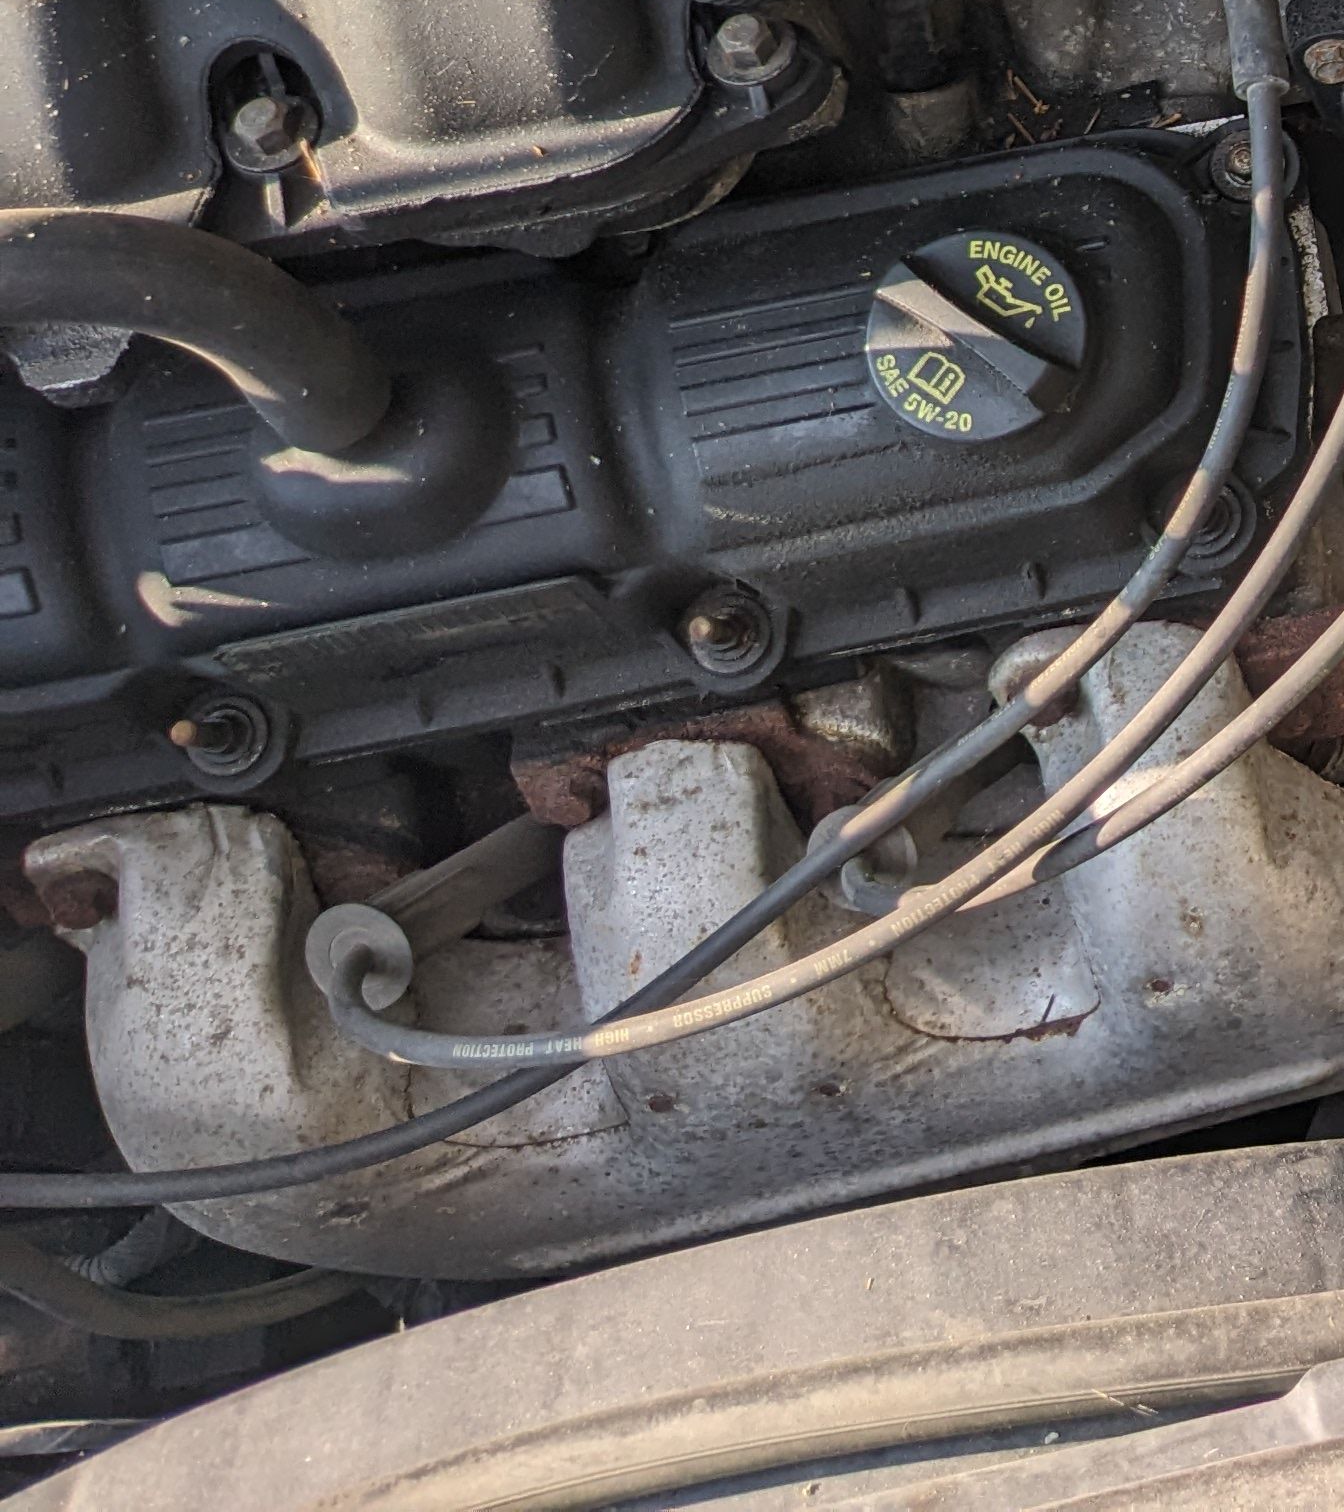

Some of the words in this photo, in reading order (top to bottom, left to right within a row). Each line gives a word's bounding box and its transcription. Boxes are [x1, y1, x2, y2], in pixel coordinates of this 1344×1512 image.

[969, 239, 1052, 287] ENGINE
[1044, 282, 1073, 323] OIL
[876, 354, 910, 398] SAE
[903, 393, 973, 433] 5W-20
[888, 869, 988, 933] PROTECTION
[811, 947, 853, 977] 7MM
[670, 983, 773, 1028] SUPPRESSOR
[452, 1041, 533, 1058] PROTECTION
[543, 1036, 581, 1054] HEAT
[593, 1026, 629, 1046] HIGH
